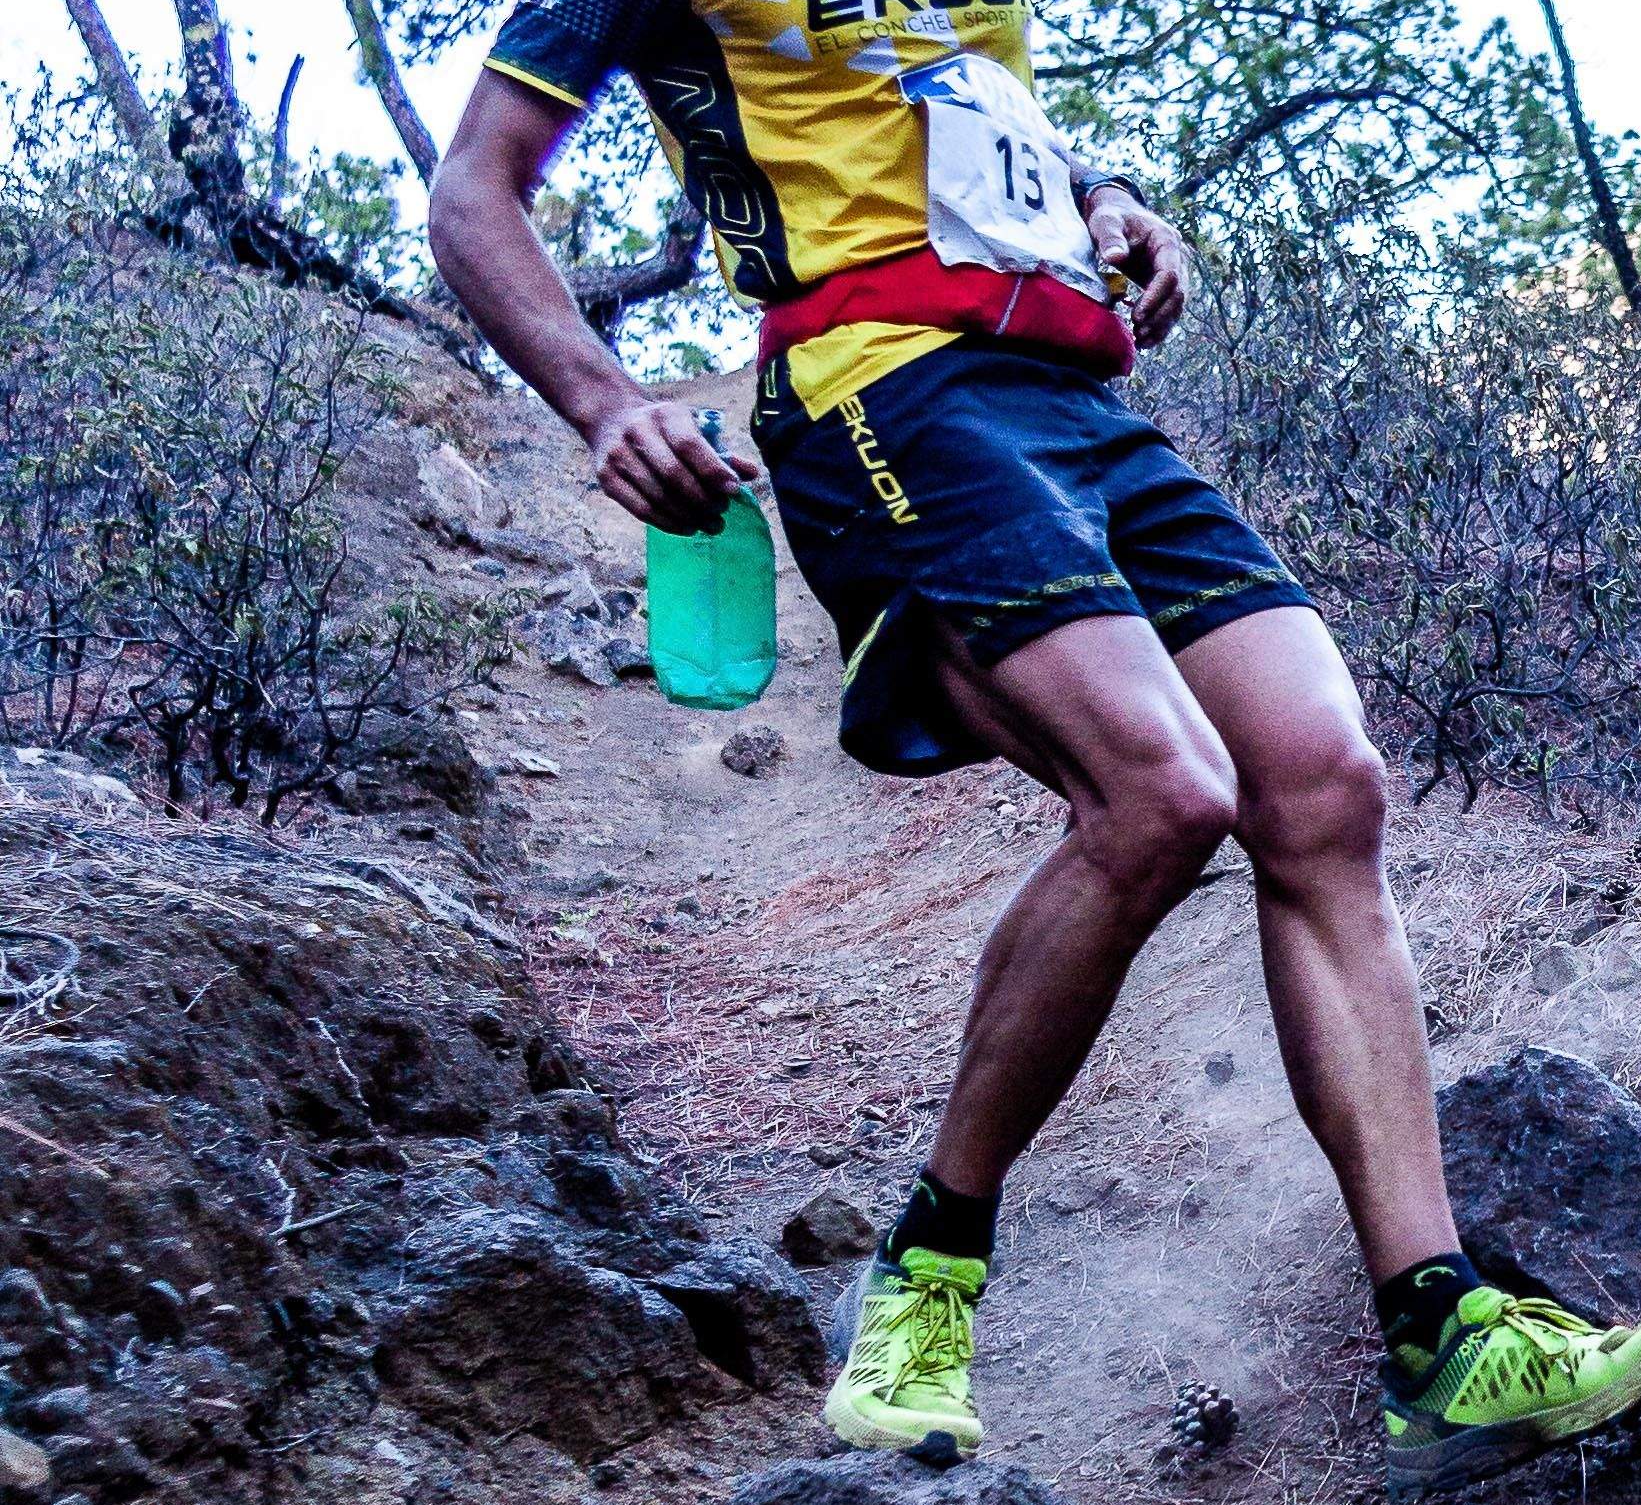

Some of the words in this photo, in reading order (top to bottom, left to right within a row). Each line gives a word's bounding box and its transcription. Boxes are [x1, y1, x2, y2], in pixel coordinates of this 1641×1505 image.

[815, 32, 849, 55] EL
[858, 13, 955, 41] CONCHEL
[995, 133, 1045, 211] 13
[838, 393, 920, 525] EKUON
